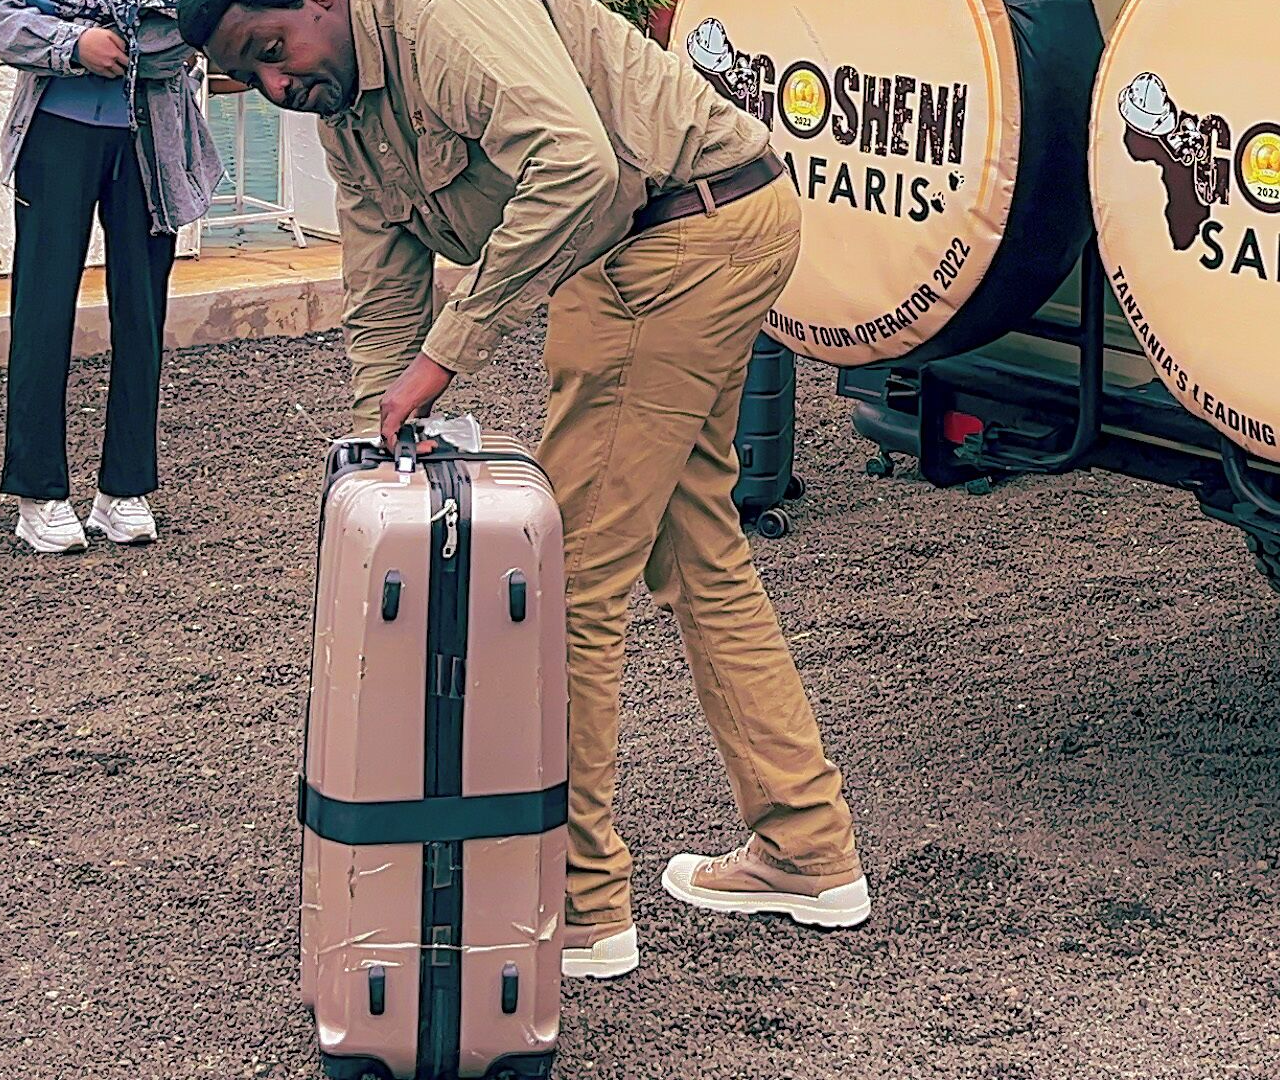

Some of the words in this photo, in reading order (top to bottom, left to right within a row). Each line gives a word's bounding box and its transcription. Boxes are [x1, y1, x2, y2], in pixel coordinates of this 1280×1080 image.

[751, 54, 968, 166] GOSHENI
[783, 151, 930, 222] FARIS
[1257, 186, 1280, 199] 2022
[765, 308, 807, 342] DING
[808, 324, 857, 348] TOUR
[854, 283, 942, 345] OPERATOR
[933, 237, 971, 291] 2022
[1111, 265, 1188, 392] TANZANIA'S
[1192, 383, 1276, 446] LEADING
